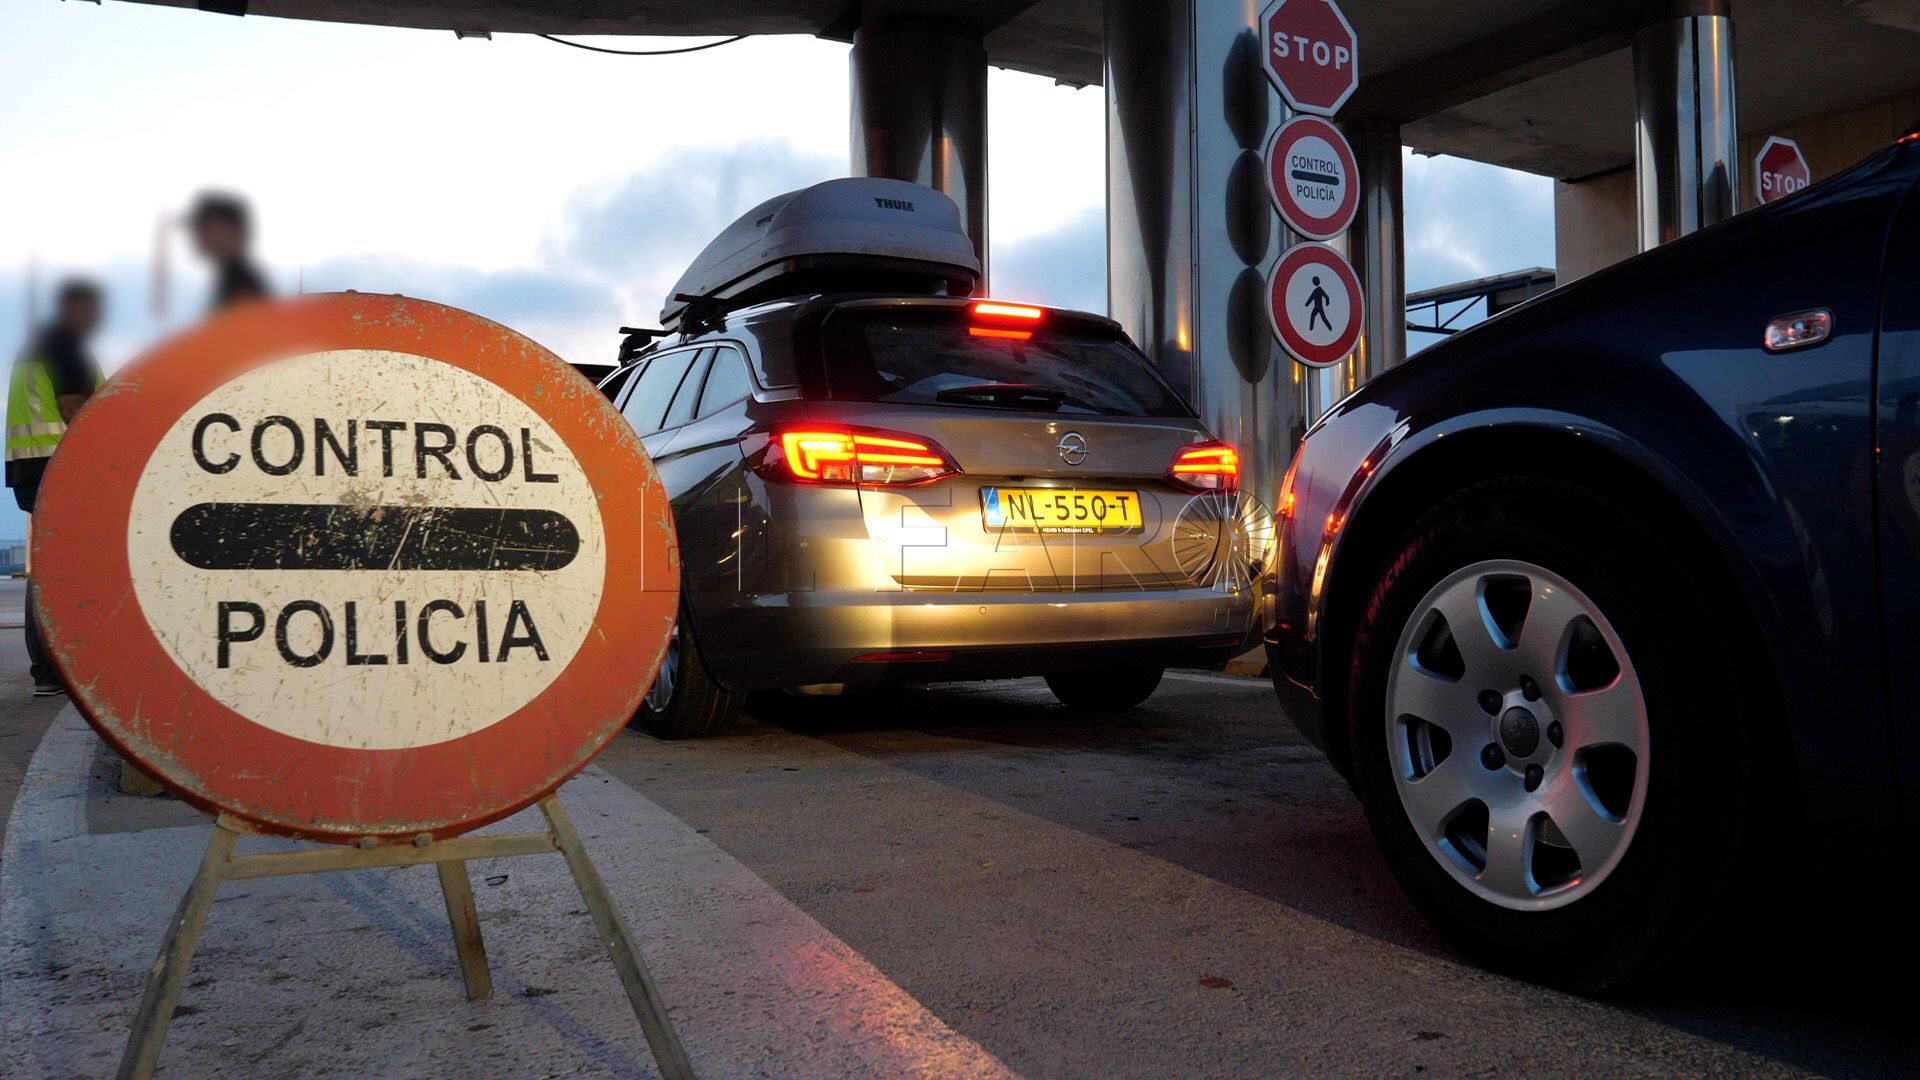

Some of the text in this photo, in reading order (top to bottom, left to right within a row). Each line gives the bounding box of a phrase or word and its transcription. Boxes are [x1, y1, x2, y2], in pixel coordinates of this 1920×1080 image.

[1273, 31, 1350, 70] STOP
[1291, 155, 1339, 174] CONTROL
[1296, 184, 1335, 202] POLICÍA
[1762, 171, 1805, 193] STOP
[875, 198, 914, 212] THULE
[191, 413, 559, 483] CONTROL
[1008, 494, 1129, 521] NL-550-T
[215, 600, 549, 669] POLICIA
